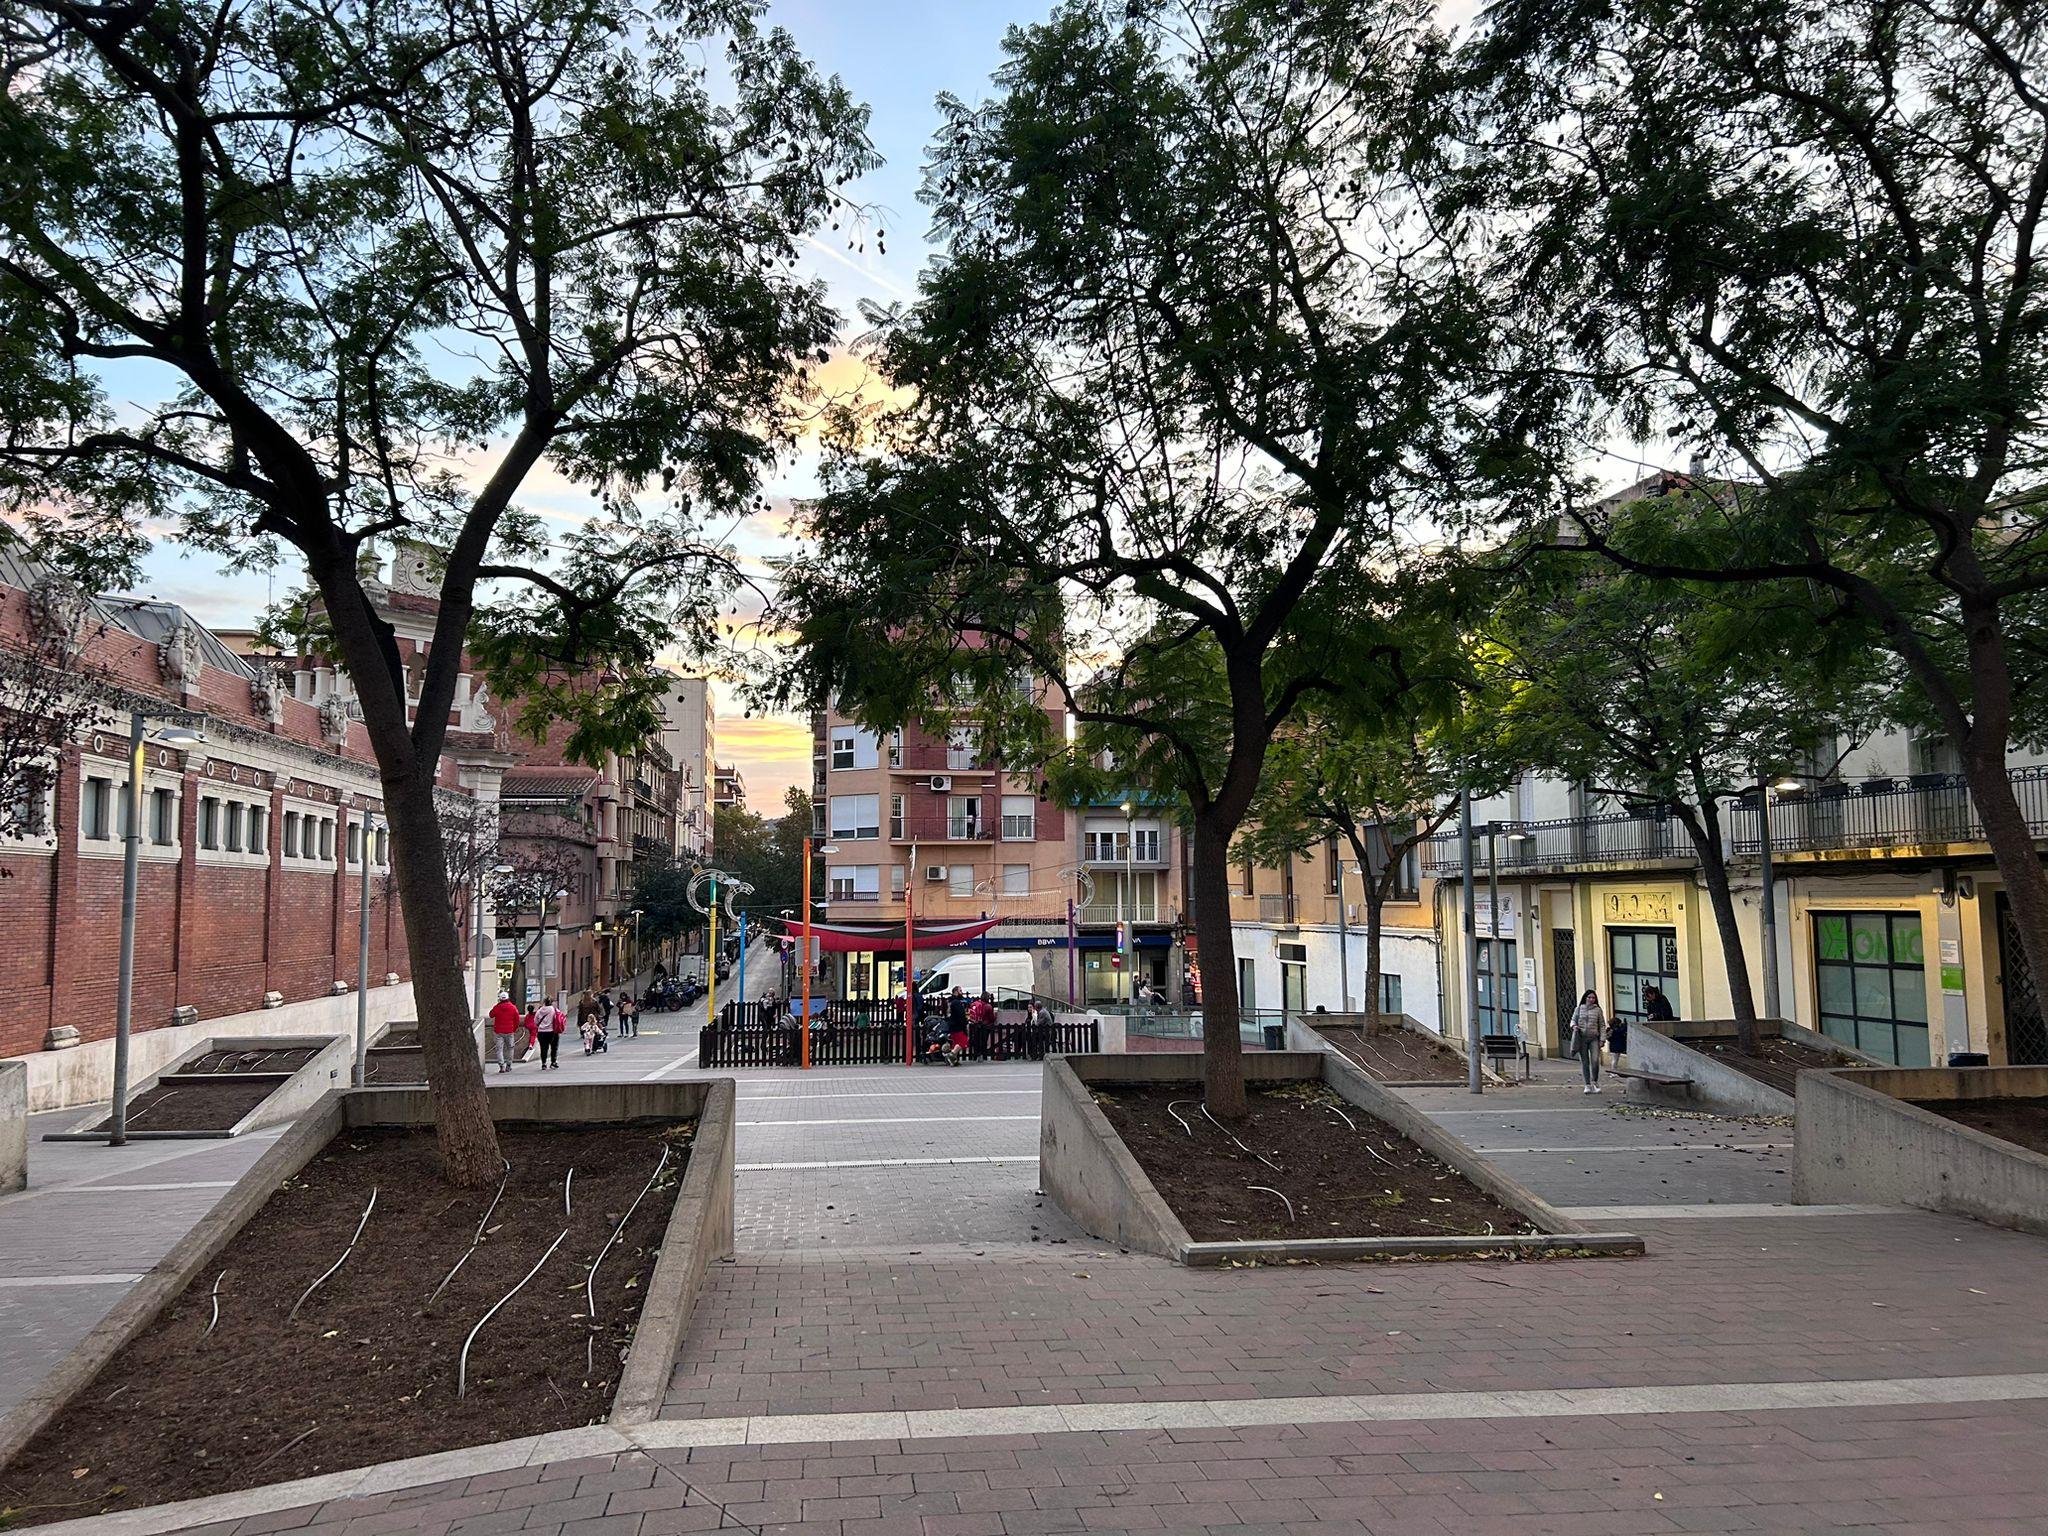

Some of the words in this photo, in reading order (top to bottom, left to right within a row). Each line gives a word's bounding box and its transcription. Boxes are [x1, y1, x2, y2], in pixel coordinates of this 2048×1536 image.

[1037, 938, 1056, 946] BBVA
[1665, 938, 1675, 947] LA
[1641, 978, 1650, 987] LA
